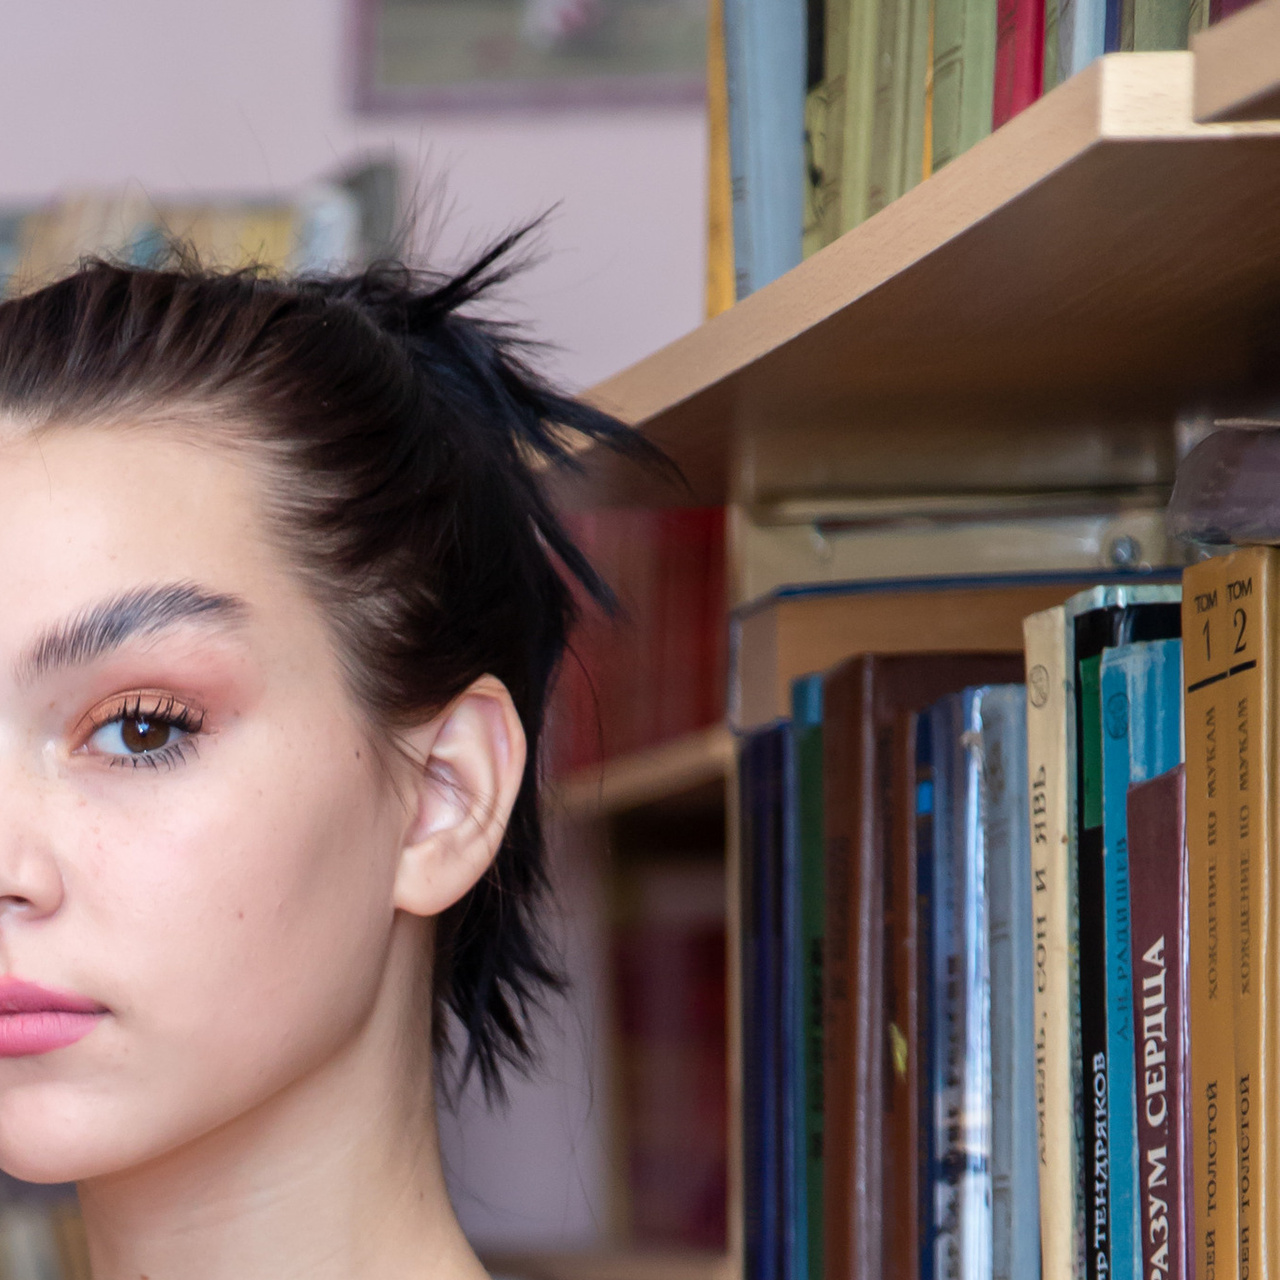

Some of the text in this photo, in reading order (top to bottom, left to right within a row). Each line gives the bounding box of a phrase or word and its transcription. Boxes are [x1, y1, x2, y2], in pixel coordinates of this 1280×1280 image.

[1194, 588, 1218, 615] ТОМ
[1226, 577, 1253, 603] ТОМ
[1202, 618, 1211, 662] 1
[1233, 607, 1247, 655] 2
[1032, 764, 1047, 845] ЯВЬ
[1035, 867, 1047, 892] И
[1205, 706, 1217, 1001] ХОЖДЕНИЕ ПО МУКАМ
[1237, 697, 1251, 997] ХОЖДЕНИЕ ПО МУКАМ
[1035, 914, 1048, 994] СОН
[1142, 935, 1168, 1128] СЕРДЦА
[1092, 1051, 1110, 1248] ТЕНДРЯКОВ
[1206, 1079, 1218, 1218] ТОЛСТОЙ
[1240, 1073, 1251, 1214] ТОЛСТОЙ
